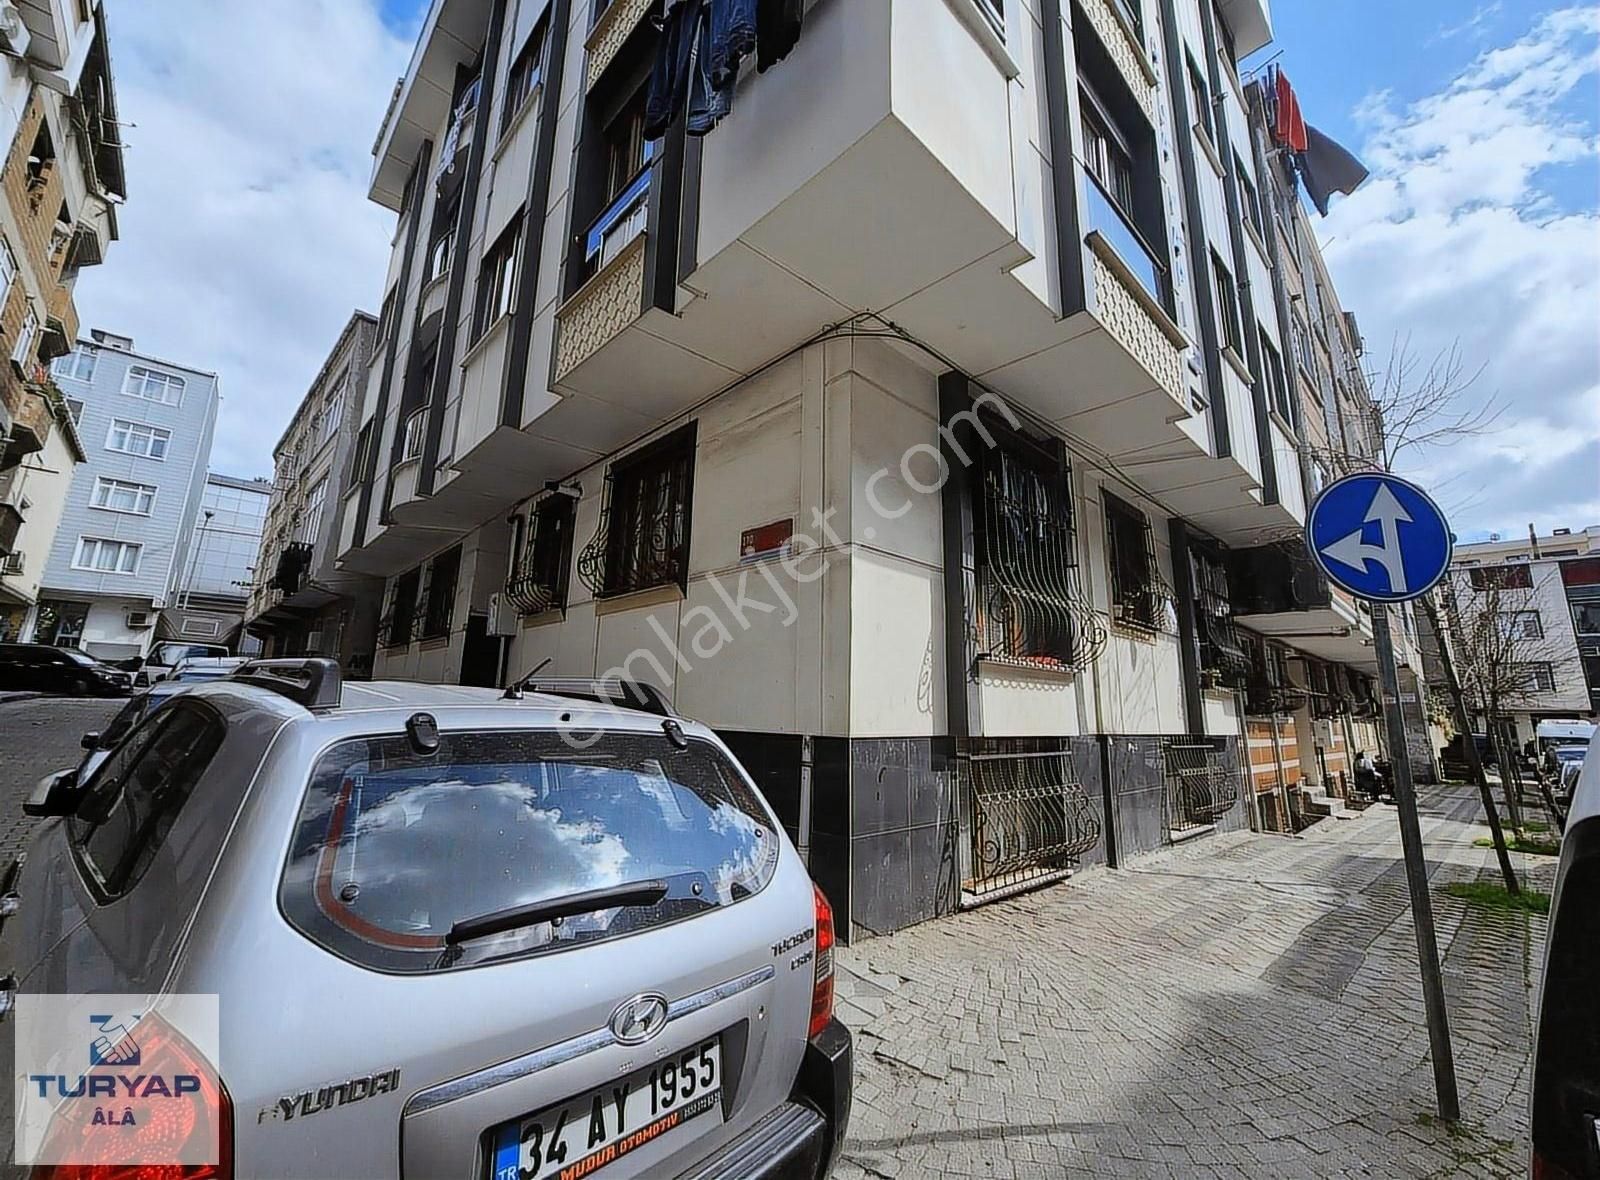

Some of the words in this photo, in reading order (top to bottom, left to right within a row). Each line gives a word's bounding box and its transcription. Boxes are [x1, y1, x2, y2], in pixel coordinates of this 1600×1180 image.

[519, 1109, 568, 1180] 34
[587, 1082, 630, 1150] AY
[648, 1041, 715, 1116] 1955
